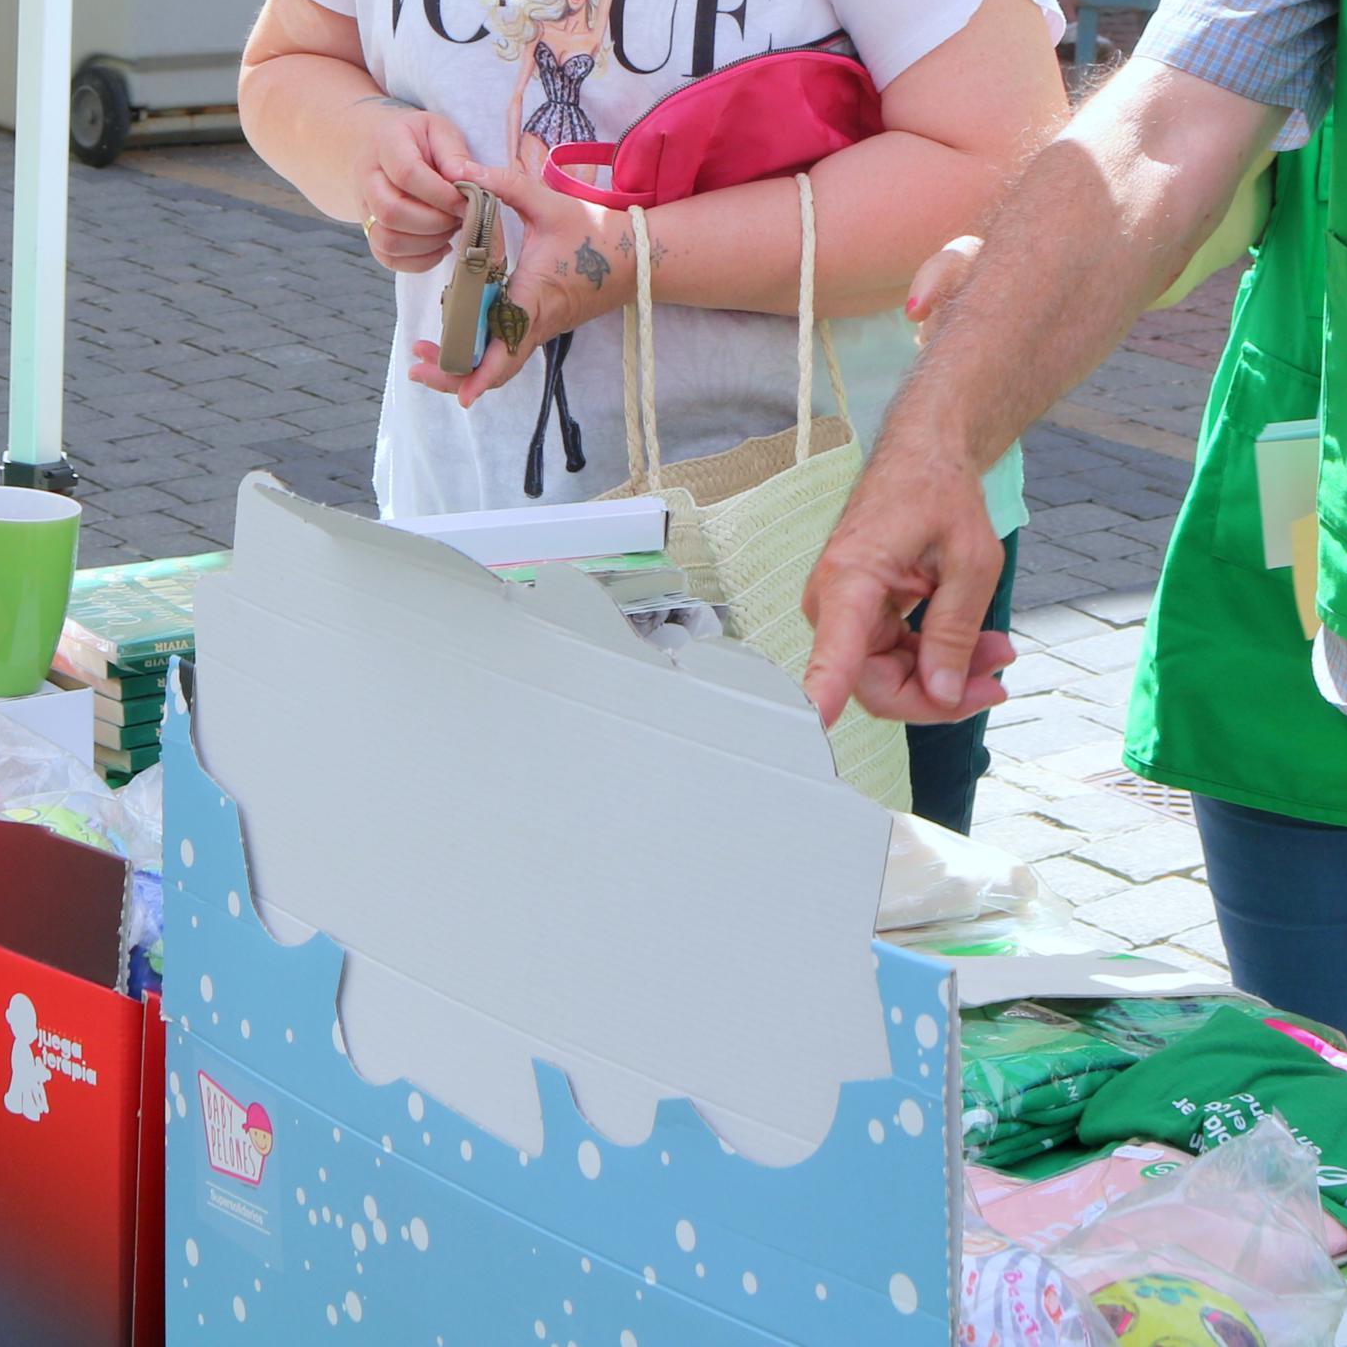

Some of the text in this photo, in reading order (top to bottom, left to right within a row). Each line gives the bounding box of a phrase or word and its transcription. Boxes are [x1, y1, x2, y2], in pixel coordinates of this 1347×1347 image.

[155, 640, 189, 653] VIVIR
[37, 1027, 82, 1060] juega
[41, 1046, 97, 1086] terapia
[206, 1086, 234, 1134] BABY
[210, 1125, 257, 1178] PELONES
